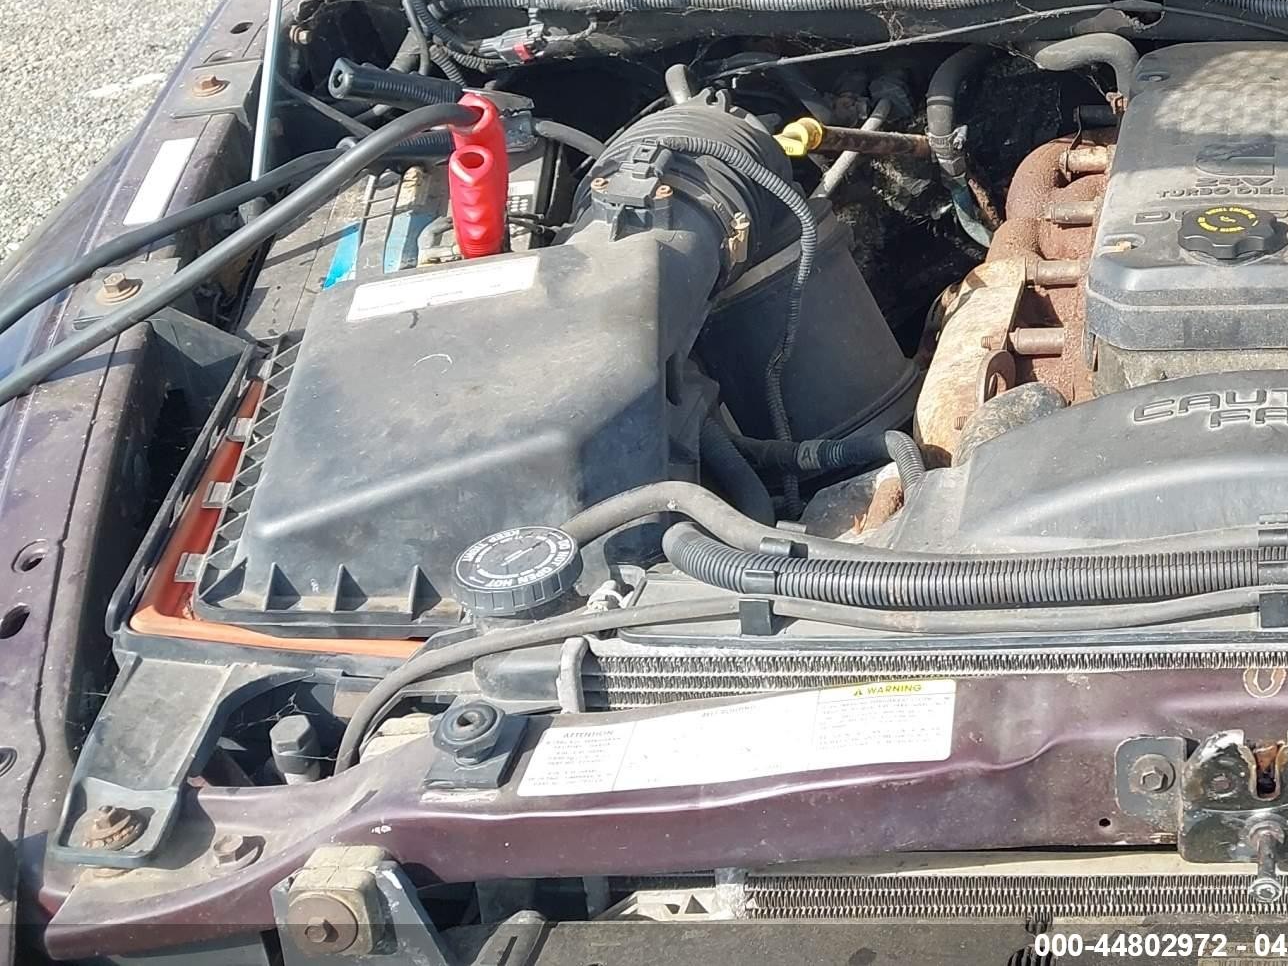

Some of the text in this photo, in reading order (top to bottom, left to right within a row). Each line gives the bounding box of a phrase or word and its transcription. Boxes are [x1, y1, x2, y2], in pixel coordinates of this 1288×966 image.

[1195, 176, 1274, 188] 24V
[1156, 186, 1231, 199] TURBO
[517, 566, 553, 585] OPEN
[867, 684, 922, 695] WARNING
